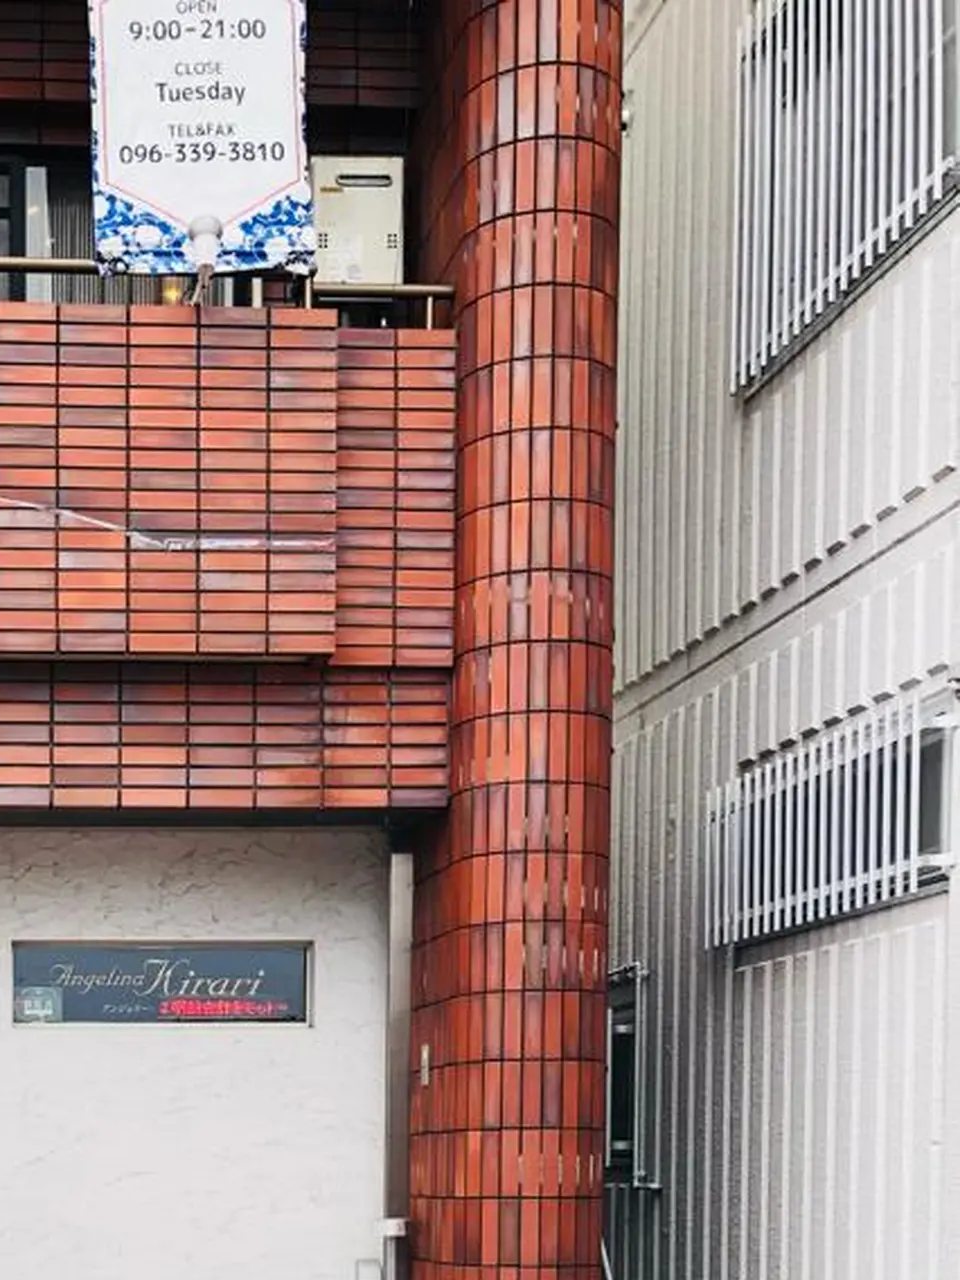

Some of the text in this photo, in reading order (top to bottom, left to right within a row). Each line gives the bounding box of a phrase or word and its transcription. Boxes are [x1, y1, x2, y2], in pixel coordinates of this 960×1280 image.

[176, 0, 218, 14] OPEN
[128, 19, 266, 41] 9:00-21:00
[174, 62, 223, 76] CLOSE
[156, 82, 246, 104] Tuesday
[169, 124, 236, 138] TEL&FAX
[119, 142, 285, 164] 096-339-3810
[49, 958, 266, 997] Angelina Kirari
